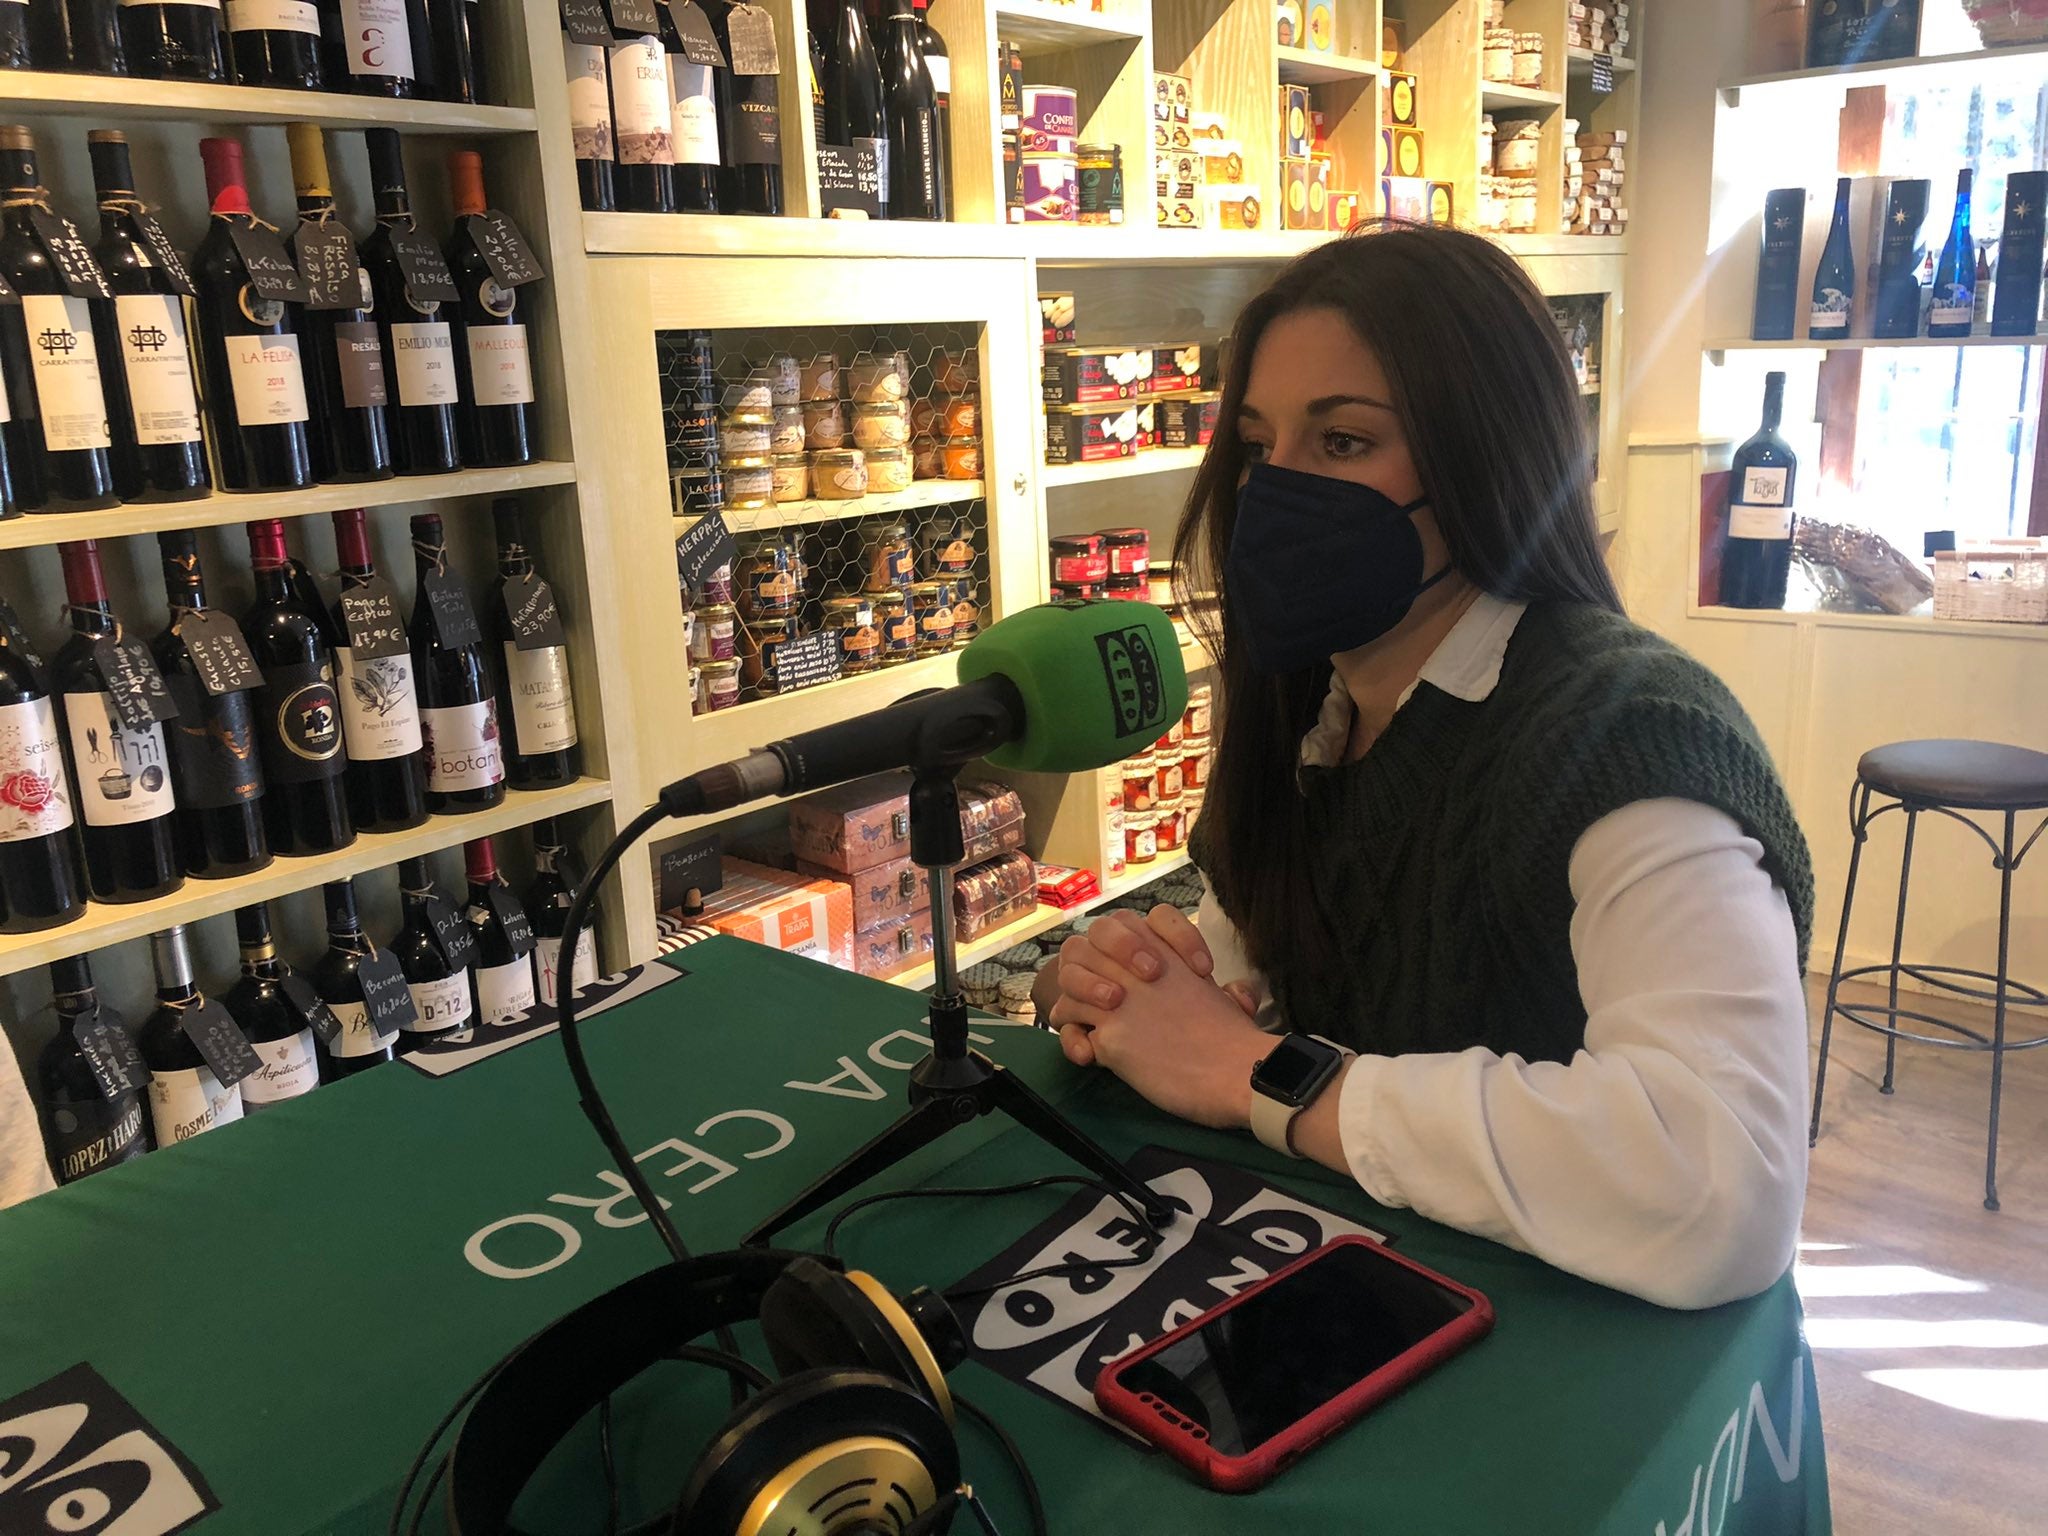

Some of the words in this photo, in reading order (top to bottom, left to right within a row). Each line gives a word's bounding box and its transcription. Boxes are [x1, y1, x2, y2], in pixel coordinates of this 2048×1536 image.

[399, 337, 433, 350] EMILIO
[241, 352, 261, 364] LA
[267, 378, 286, 386] 2018
[345, 598, 376, 616] Pago
[1112, 650, 1138, 720] CERO
[1134, 641, 1156, 715] ONDA
[784, 918, 812, 936] TRAPA
[424, 999, 462, 1022] D-12
[63, 1135, 108, 1178] LOPEZ
[112, 1101, 143, 1152] HARO
[463, 1109, 796, 1280] CERO
